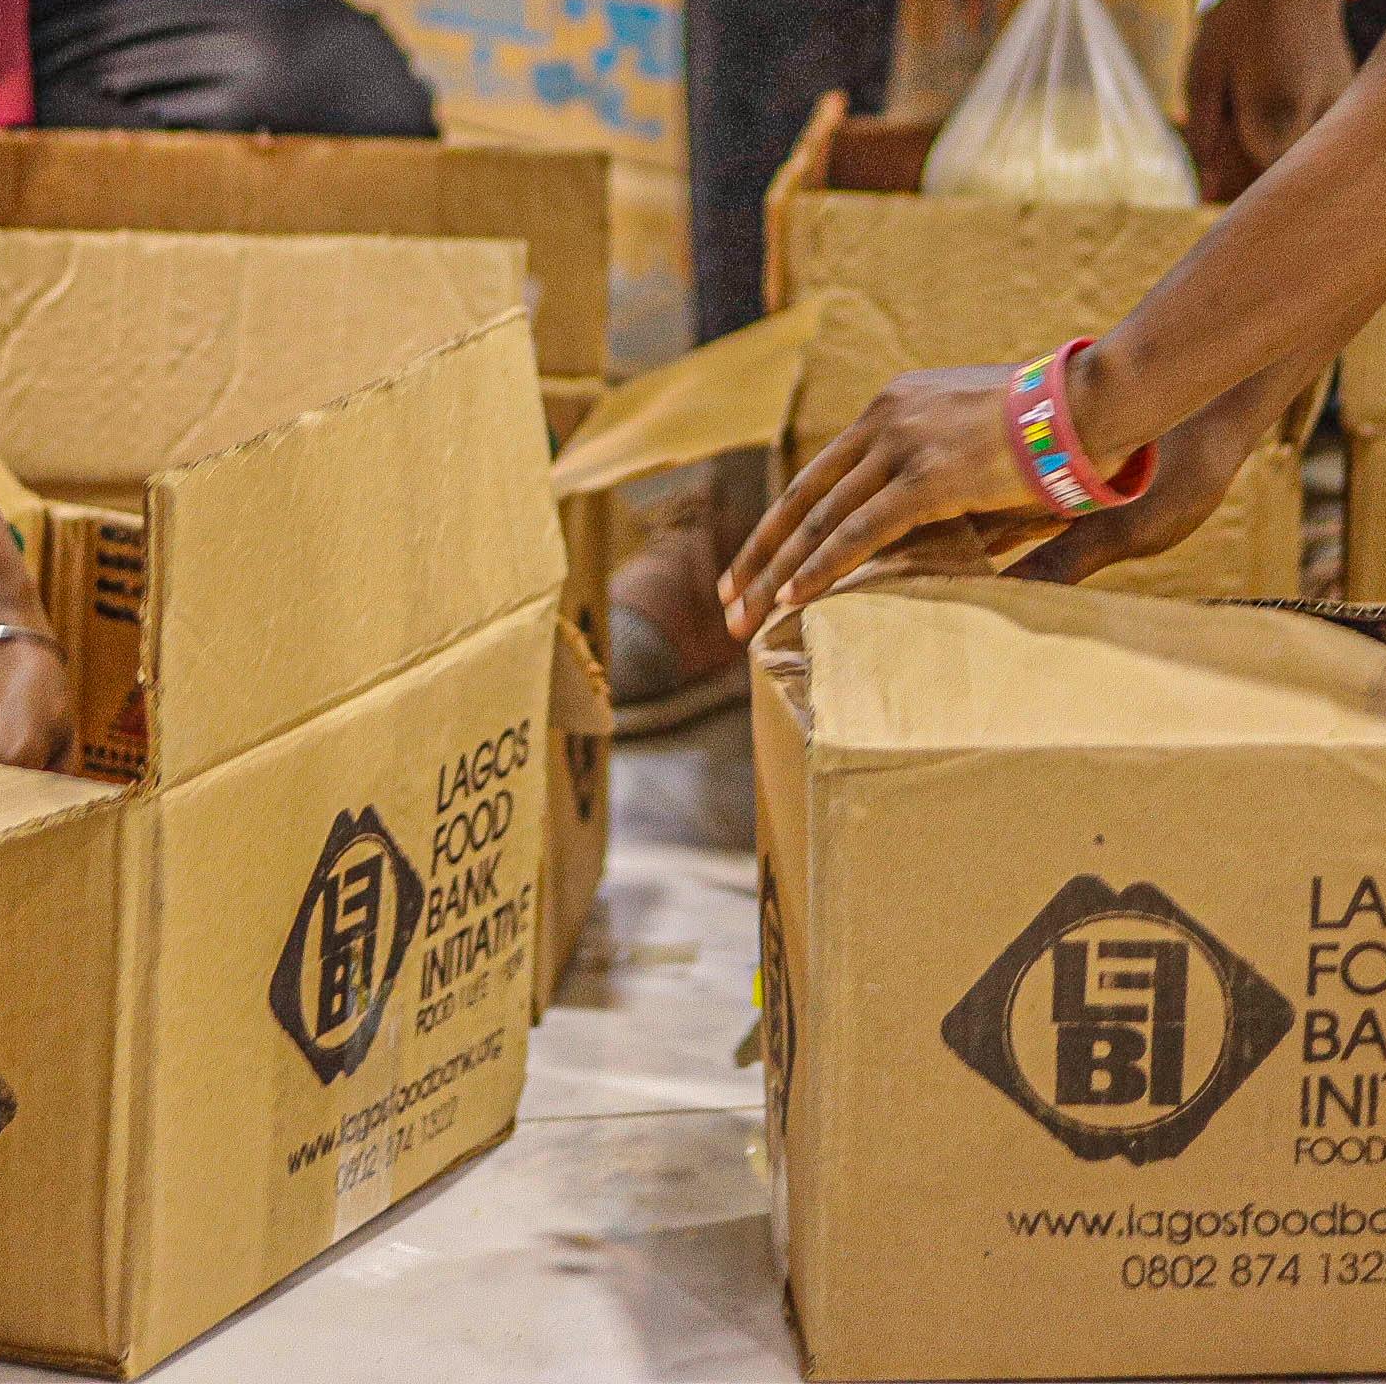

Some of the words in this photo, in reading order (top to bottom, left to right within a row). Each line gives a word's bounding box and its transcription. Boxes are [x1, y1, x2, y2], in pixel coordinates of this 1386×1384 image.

[436, 718, 531, 816] LAGOS
[430, 788, 513, 879] FOOD
[426, 850, 501, 938] BANK
[1121, 1252, 1218, 1290] 0802
[1229, 1250, 1301, 1288] 874
